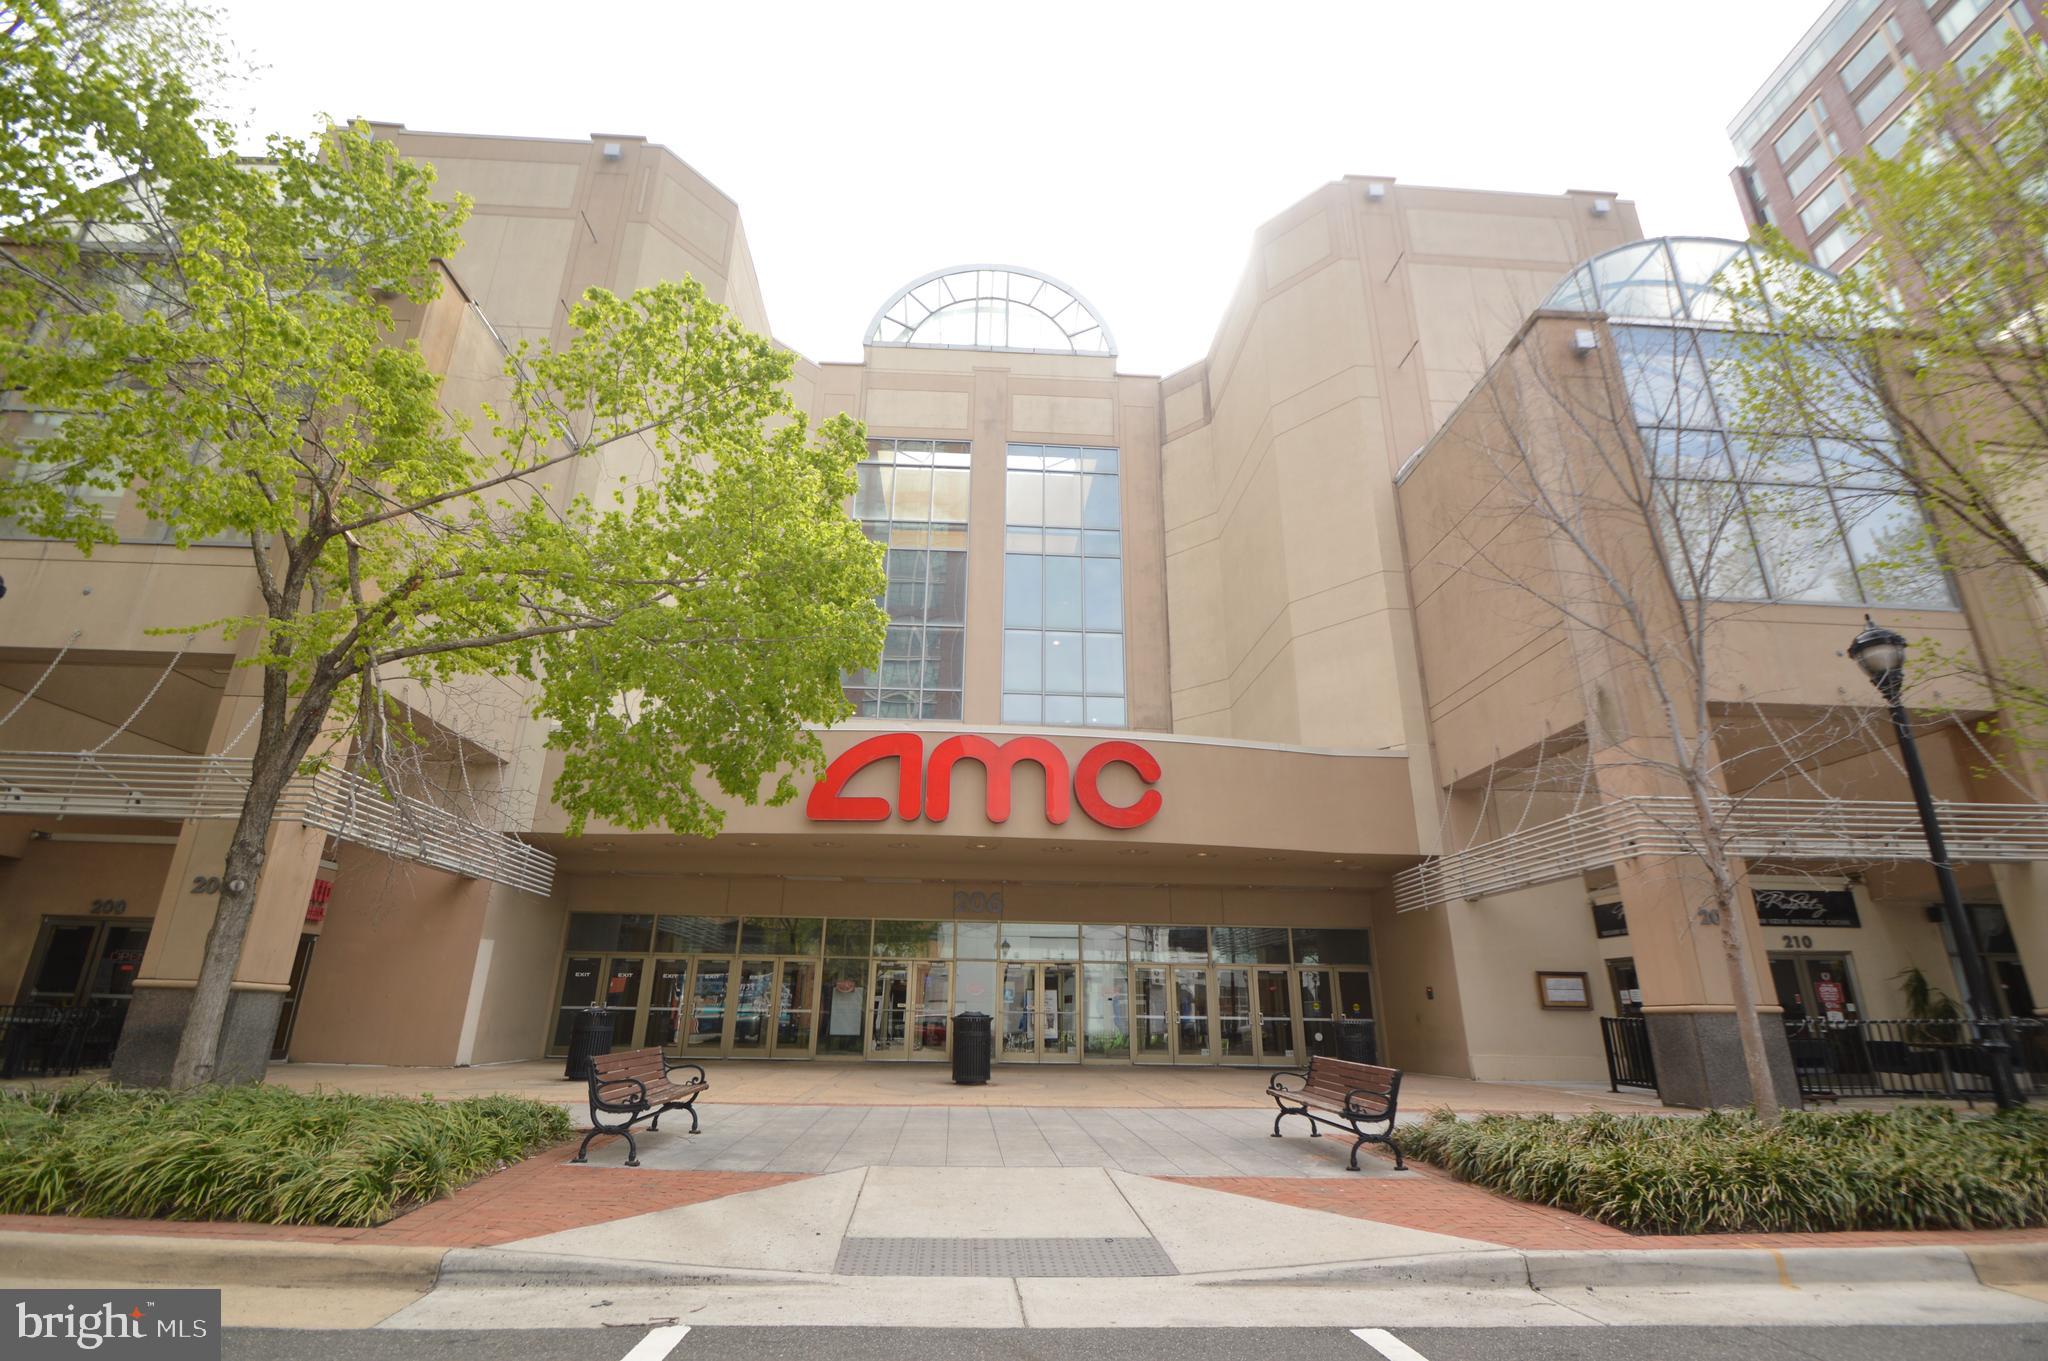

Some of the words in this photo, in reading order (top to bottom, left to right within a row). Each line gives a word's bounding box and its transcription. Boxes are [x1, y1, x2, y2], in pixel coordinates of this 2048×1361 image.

[191, 876, 225, 895] 20
[952, 891, 1005, 913] 206
[1782, 935, 1812, 949] 210
